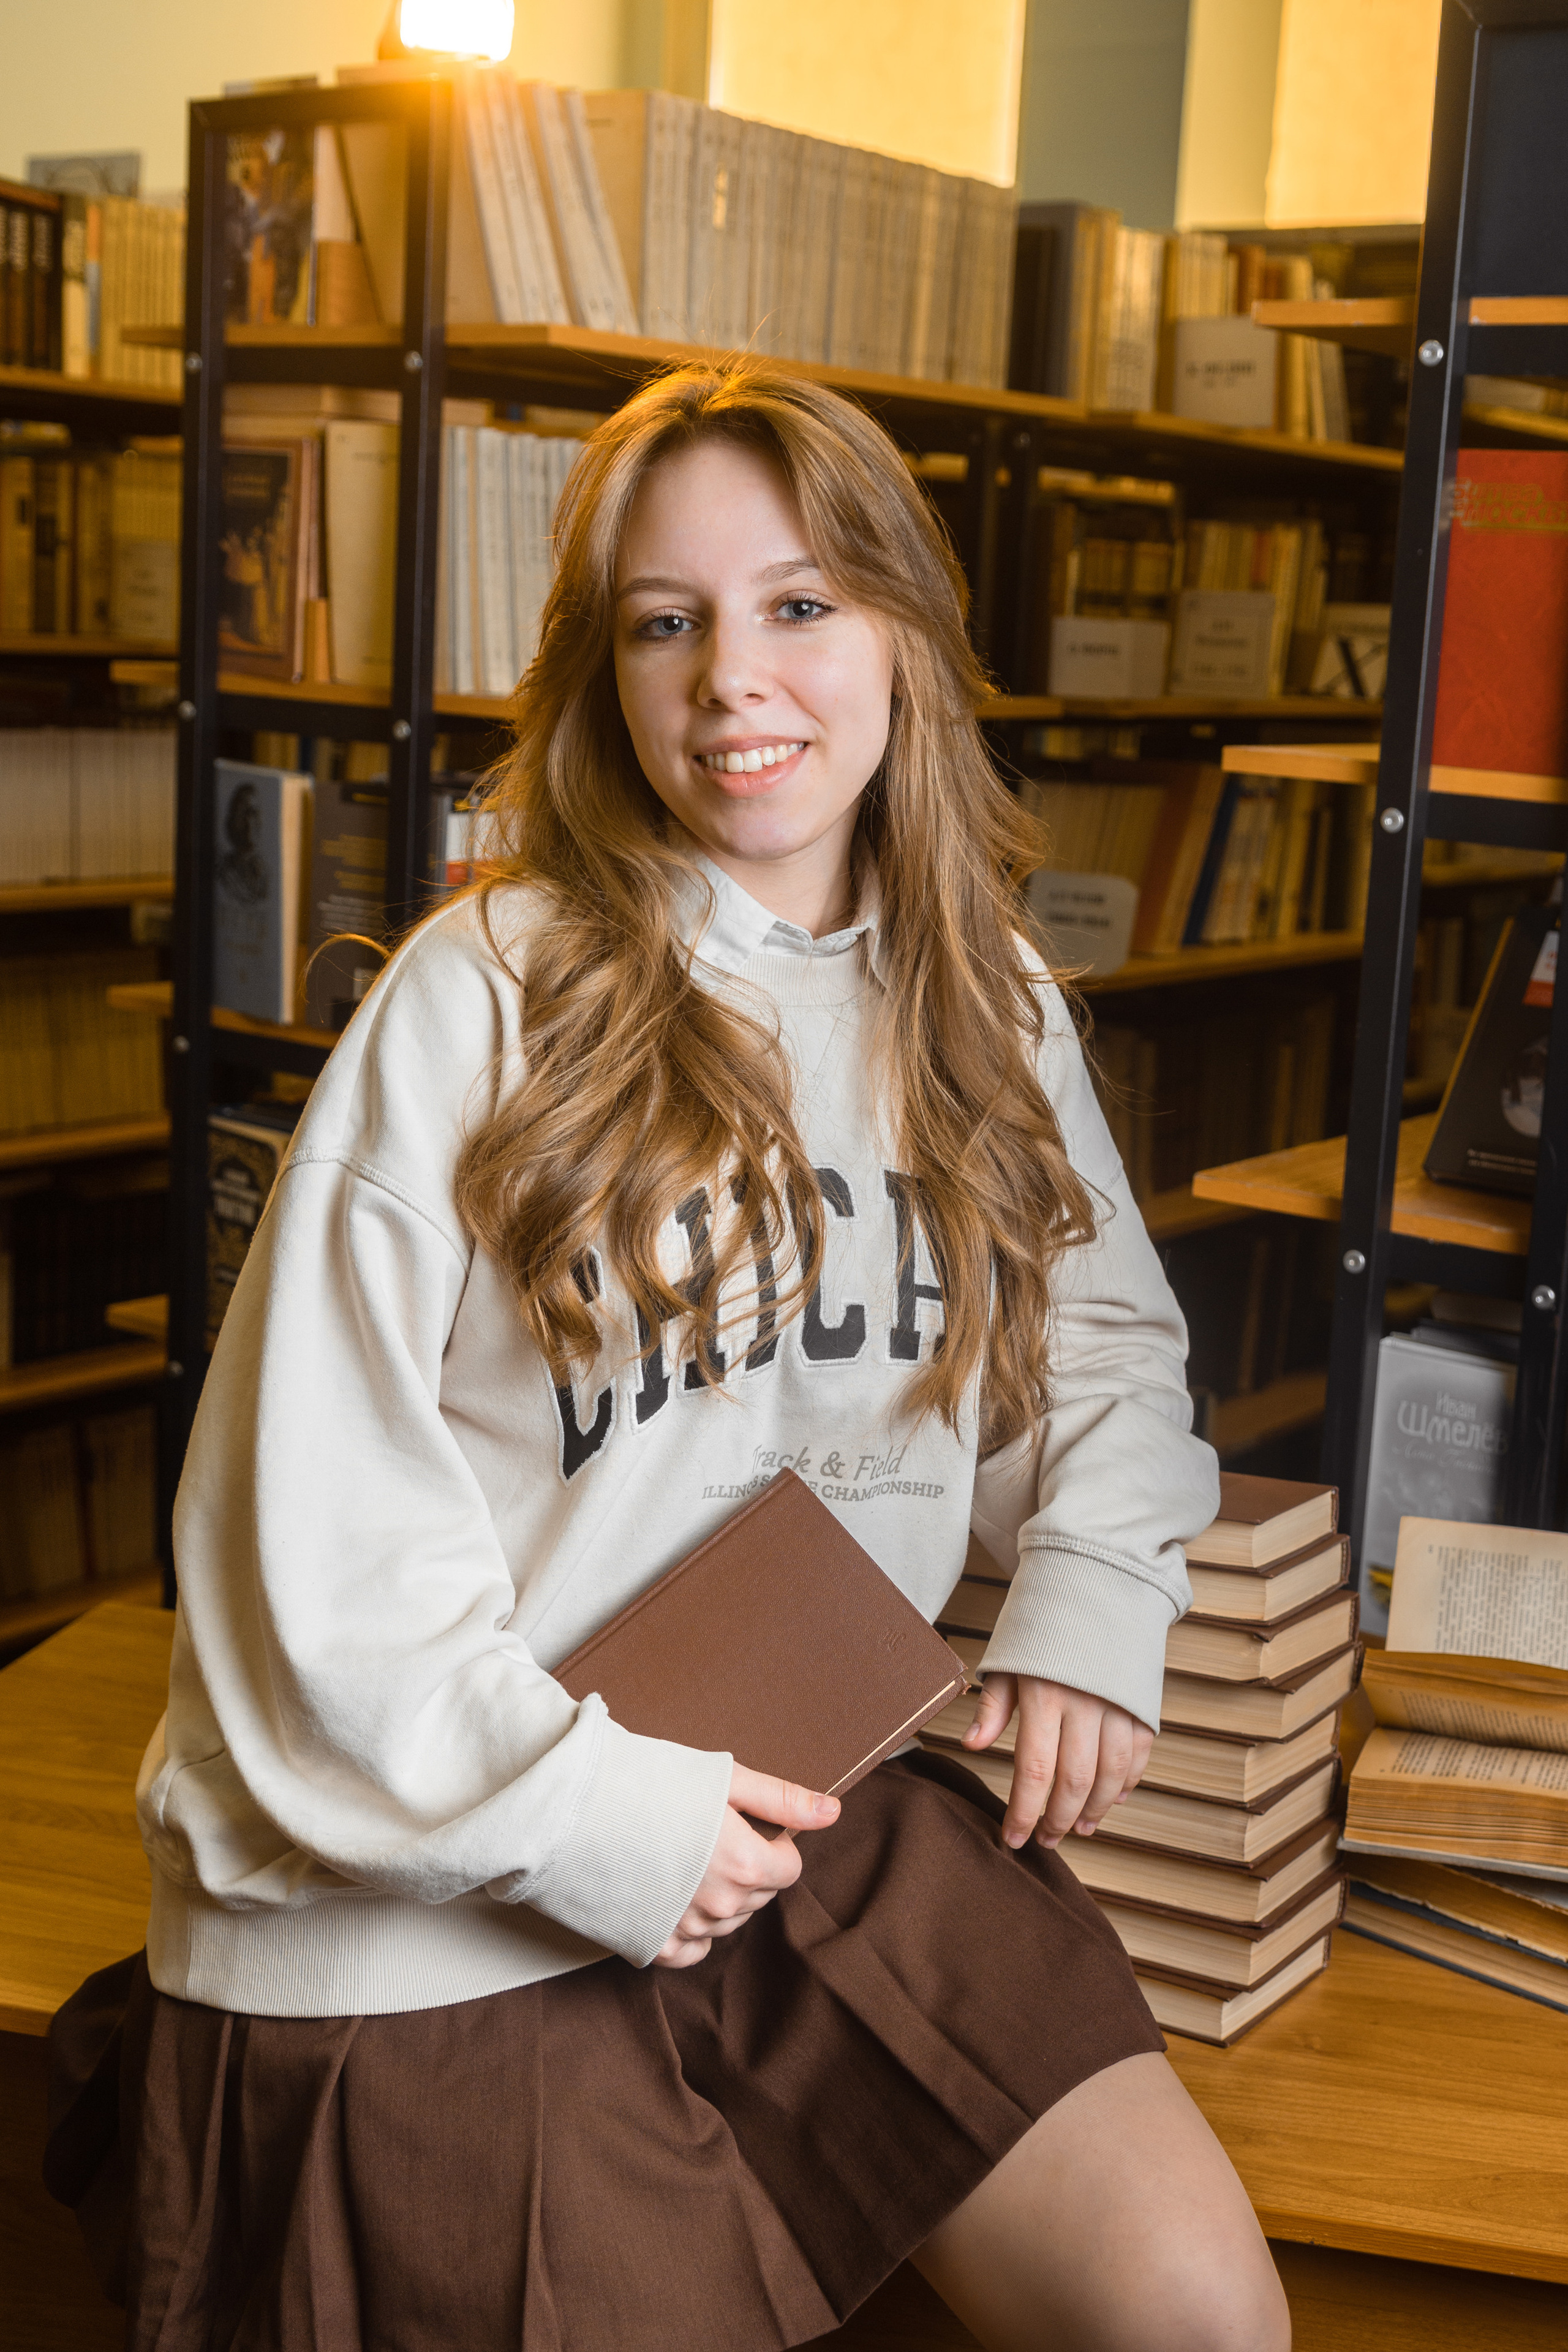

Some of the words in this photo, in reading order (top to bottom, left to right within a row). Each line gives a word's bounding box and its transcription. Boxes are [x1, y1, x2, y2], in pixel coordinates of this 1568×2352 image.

[752, 1444, 811, 1474] Track
[820, 1451, 845, 1479] &
[853, 1444, 909, 1481] Field
[821, 1480, 944, 1502] CHAMPIONSHIP
